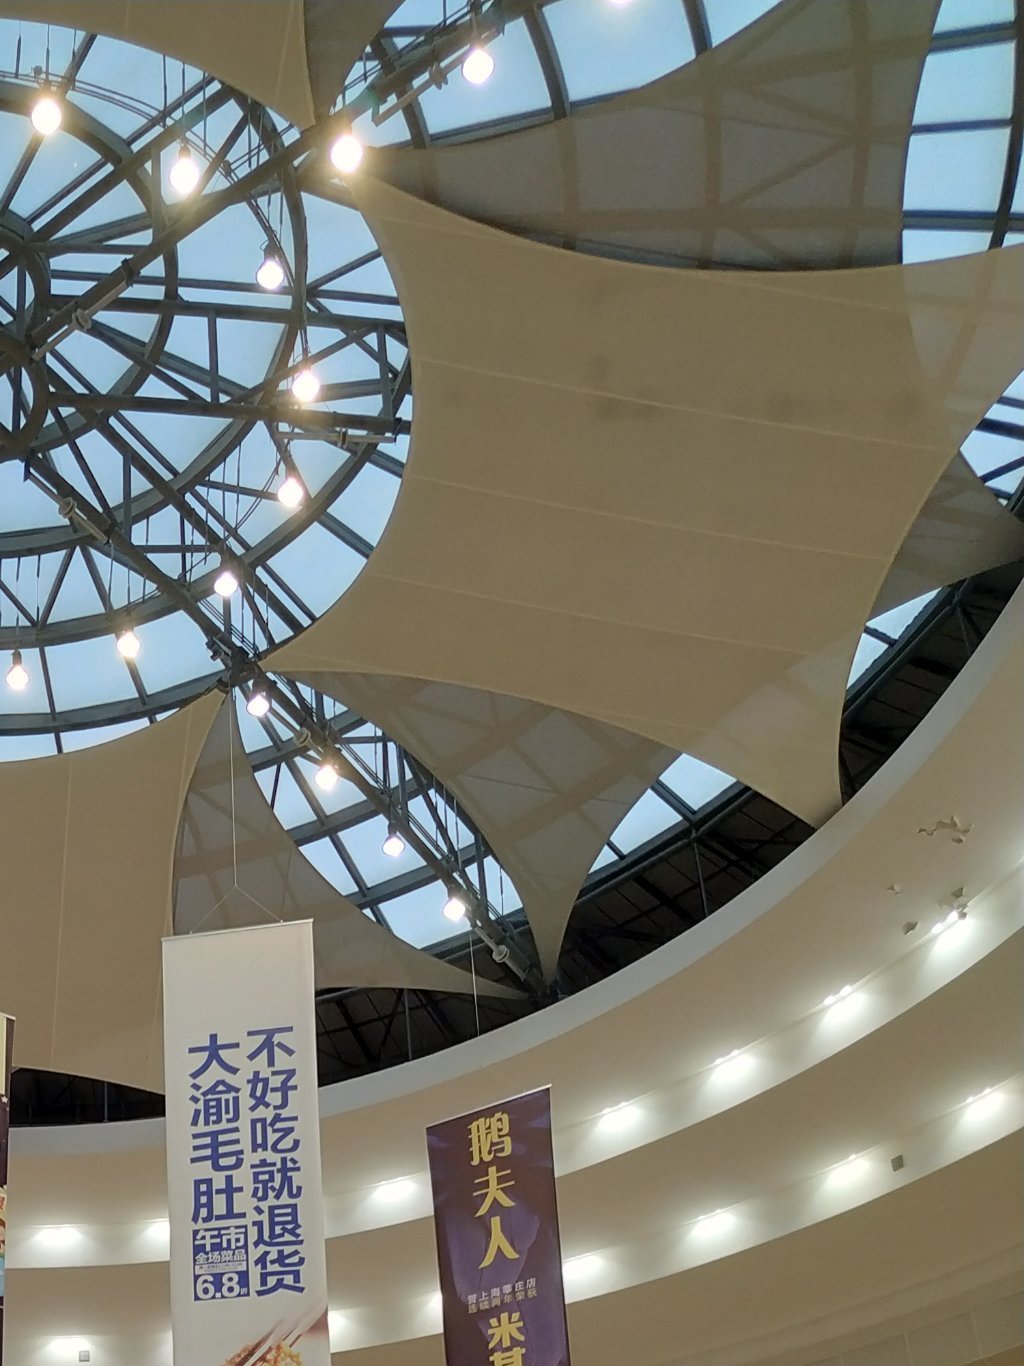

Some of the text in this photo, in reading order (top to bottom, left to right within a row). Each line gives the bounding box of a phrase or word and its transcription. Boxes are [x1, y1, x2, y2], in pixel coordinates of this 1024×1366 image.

[188, 1032, 247, 1225] 大渝毛肚
[246, 1026, 306, 1297] 不好吃就退货
[467, 1110, 521, 1269] 鹅夫人
[194, 1227, 245, 1251] 午市
[195, 1249, 246, 1264] 全场菜品
